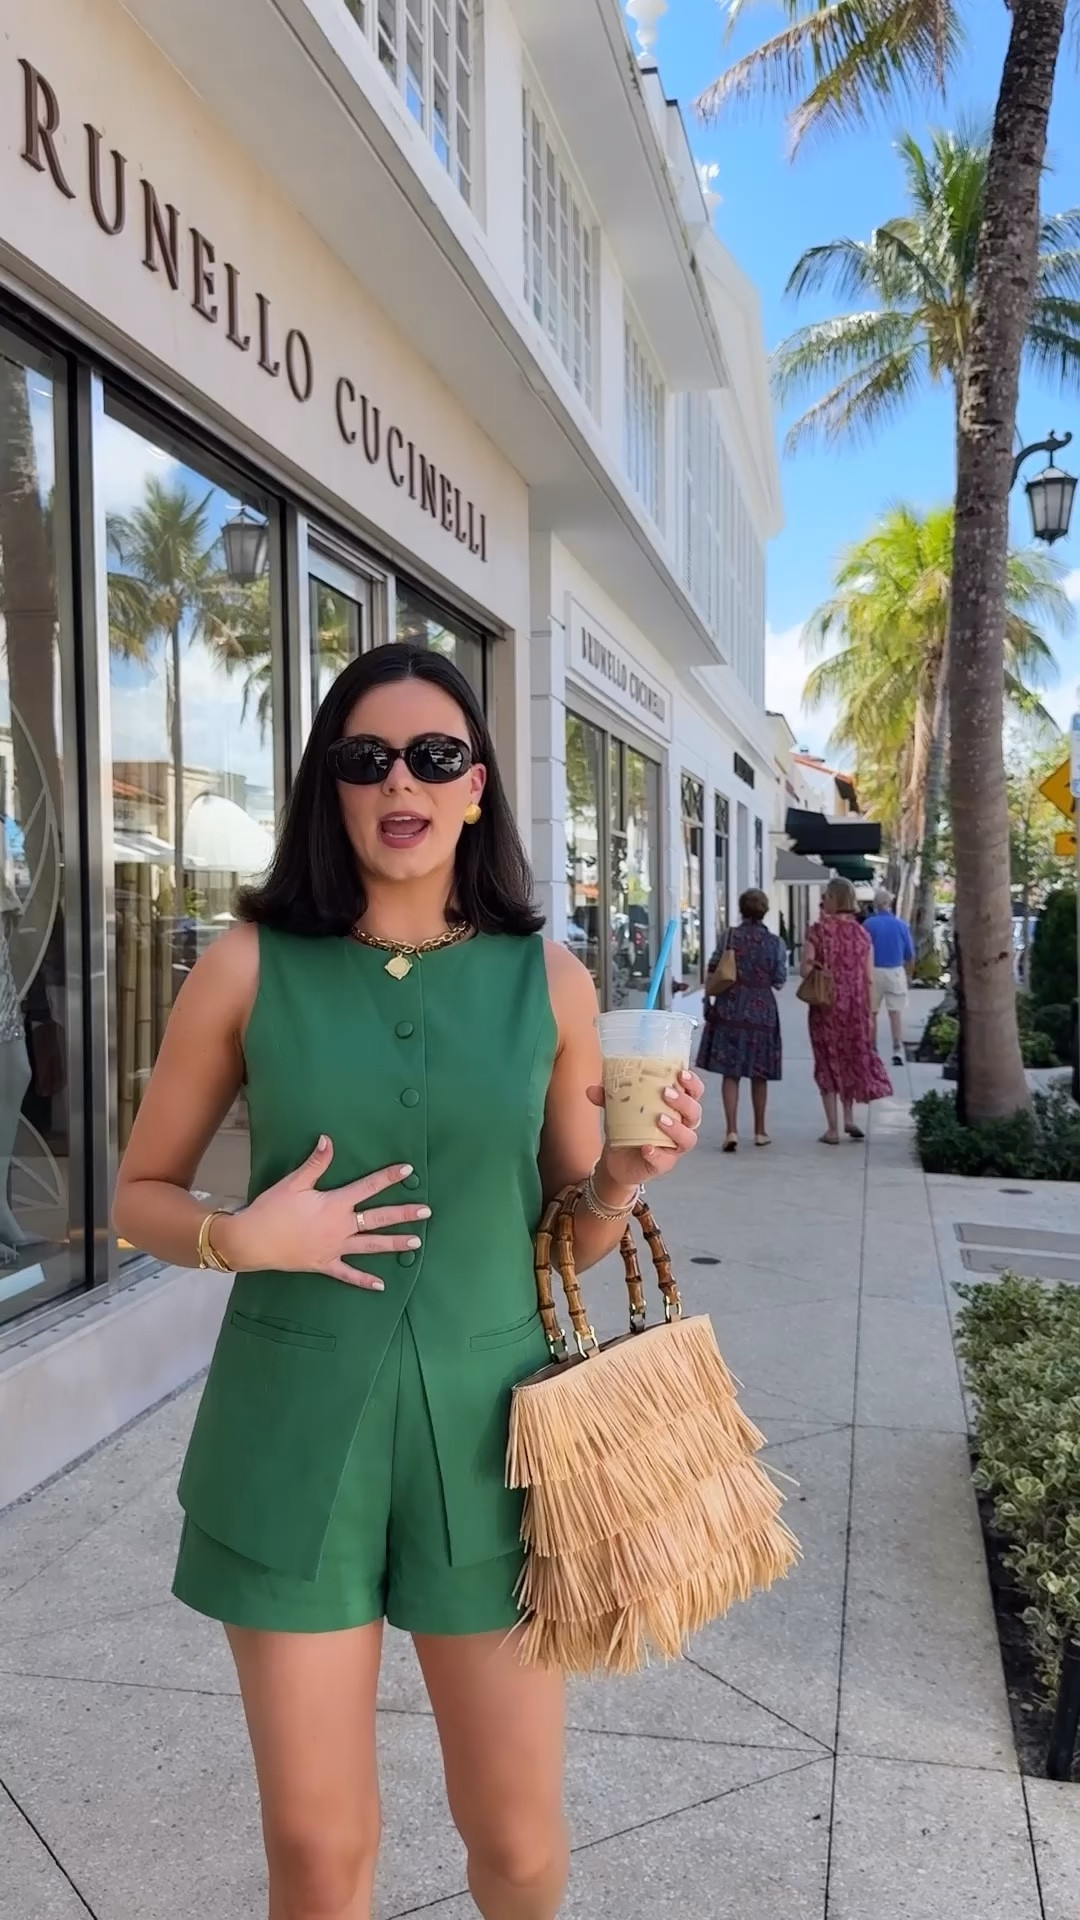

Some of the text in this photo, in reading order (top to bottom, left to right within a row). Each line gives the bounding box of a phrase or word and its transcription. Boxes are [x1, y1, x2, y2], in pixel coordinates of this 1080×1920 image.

[18, 58, 488, 563] RUNELLO CUCINELLI
[630, 671, 666, 724] CUCIE
